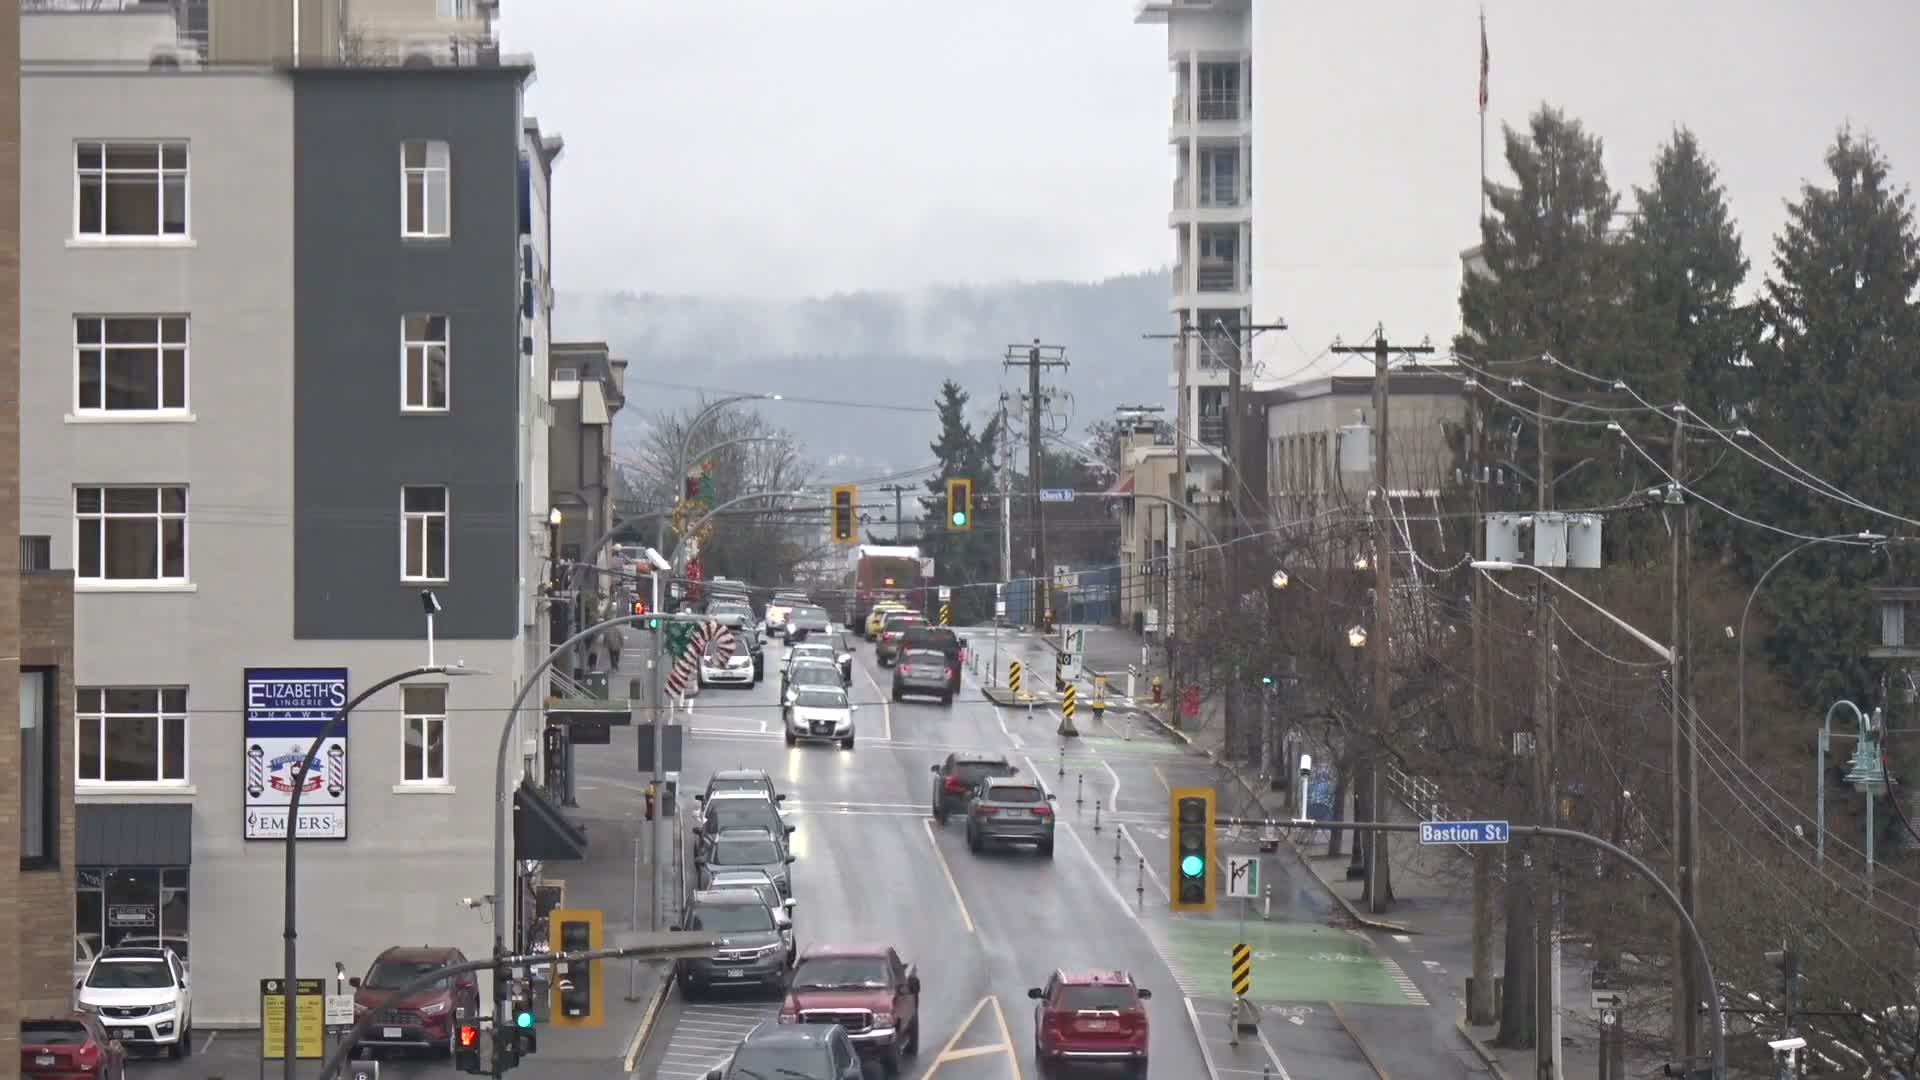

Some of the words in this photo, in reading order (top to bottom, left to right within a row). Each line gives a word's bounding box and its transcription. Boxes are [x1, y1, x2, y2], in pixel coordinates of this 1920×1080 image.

[248, 683, 345, 707] ELIZABETH'S
[260, 816, 331, 830] EMERS
[1422, 824, 1479, 841] Bastion
[1485, 824, 1507, 840] St.
